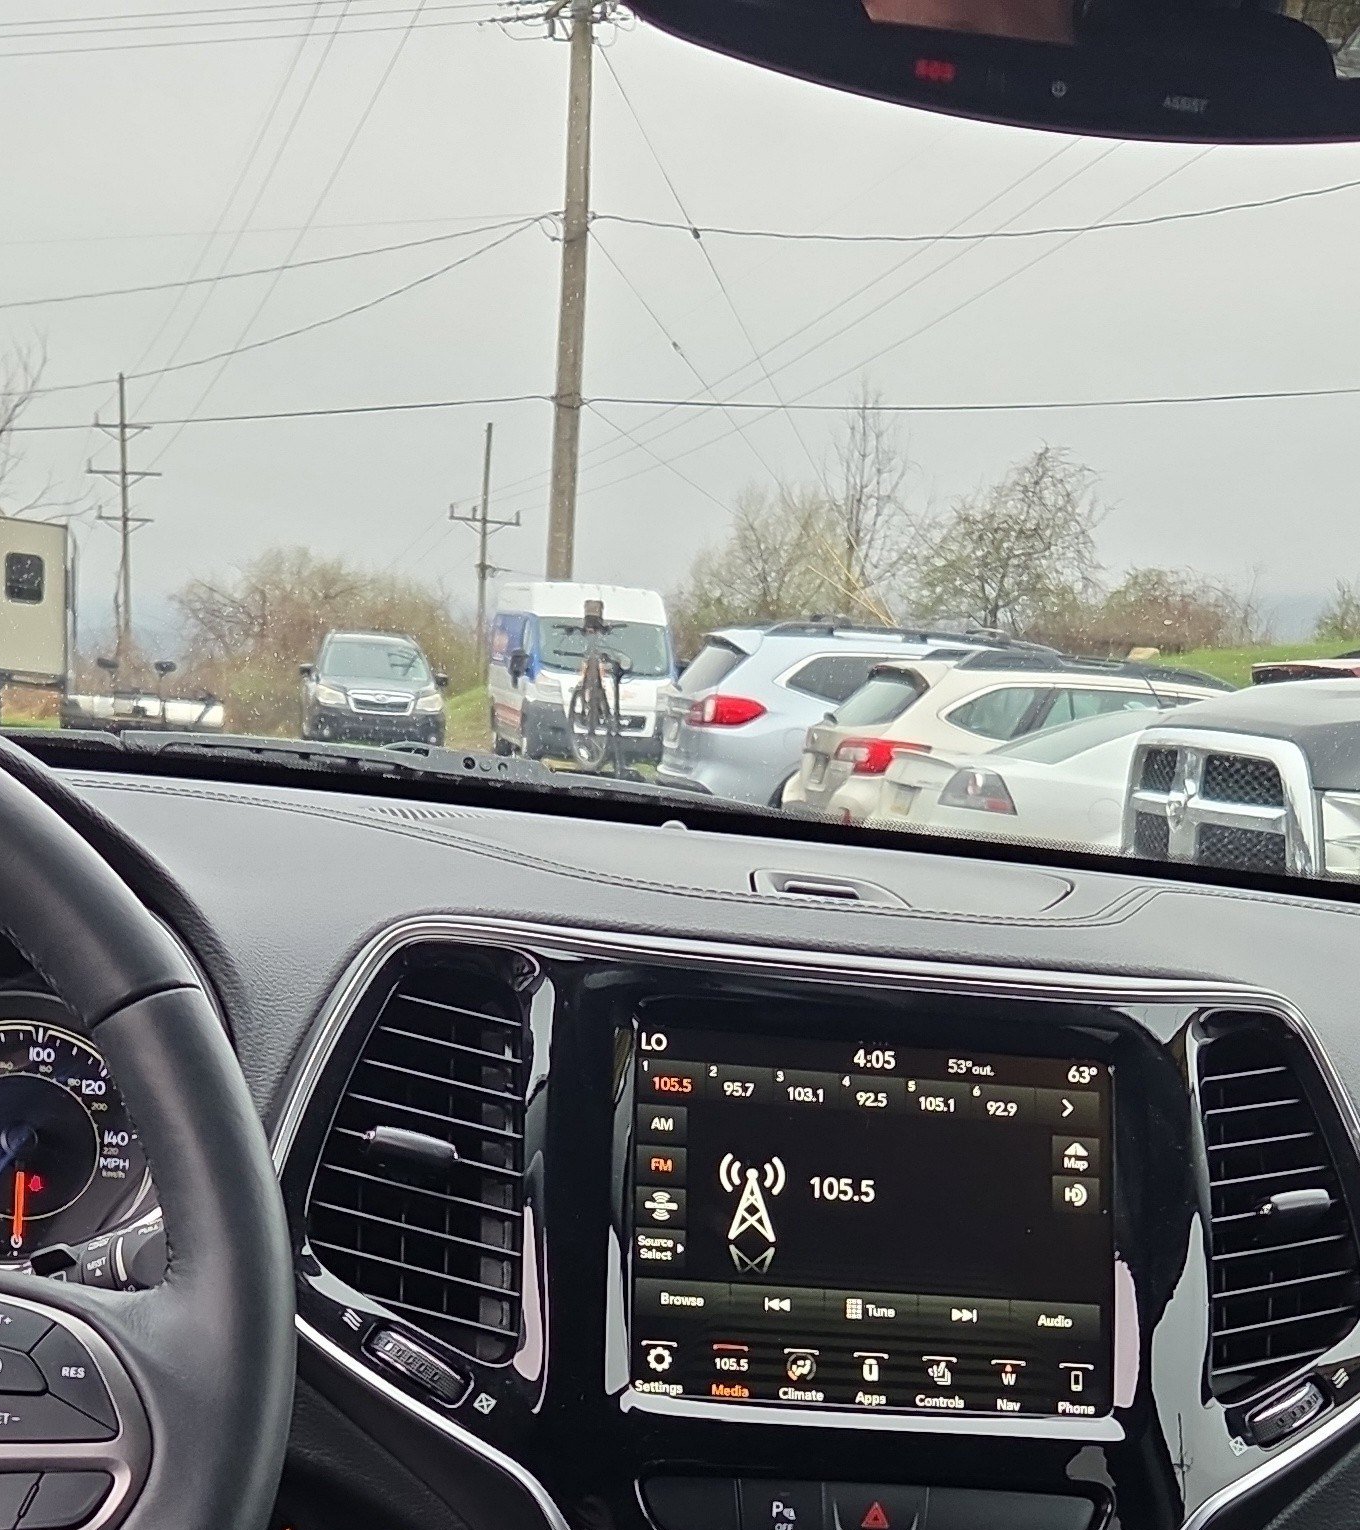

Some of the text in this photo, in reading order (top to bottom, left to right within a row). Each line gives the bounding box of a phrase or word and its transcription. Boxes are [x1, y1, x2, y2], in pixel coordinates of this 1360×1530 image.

[640, 1031, 668, 1051] LO
[28, 1045, 55, 1063] 100
[853, 1048, 896, 1070] 4:05
[642, 1060, 649, 1072] 1
[709, 1065, 718, 1077] 2
[776, 1070, 785, 1083] 3
[841, 1075, 851, 1087] 4
[81, 1079, 106, 1096] 120
[652, 1076, 692, 1093] 105.5
[723, 1081, 755, 1097] 95.7
[907, 1080, 917, 1093] 5
[972, 1085, 982, 1097] 6
[787, 1086, 825, 1103] 103.1
[856, 1091, 888, 1108] 92.5
[918, 1096, 955, 1113] 105.1
[986, 1101, 1018, 1117] 92.9
[650, 1116, 674, 1131] AM
[103, 1130, 129, 1146] 140
[99, 1157, 130, 1171] MPH
[650, 1158, 674, 1173] FM
[1063, 1157, 1089, 1172] Map
[809, 1176, 876, 1203] 105.5
[637, 1235, 674, 1249] Source
[639, 1248, 673, 1261] Select
[660, 1291, 705, 1308] Browse
[866, 1304, 896, 1319] Tune
[1037, 1314, 1073, 1329] Audio
[714, 1357, 749, 1372] 105.5
[61, 1366, 86, 1379] RES
[635, 1379, 684, 1396] Settings
[711, 1383, 749, 1399] Media
[778, 1387, 825, 1402] Climate
[855, 1391, 887, 1407] Apps
[915, 1393, 965, 1410] Controls
[996, 1398, 1021, 1412] Nav
[1057, 1401, 1096, 1416] Phone
